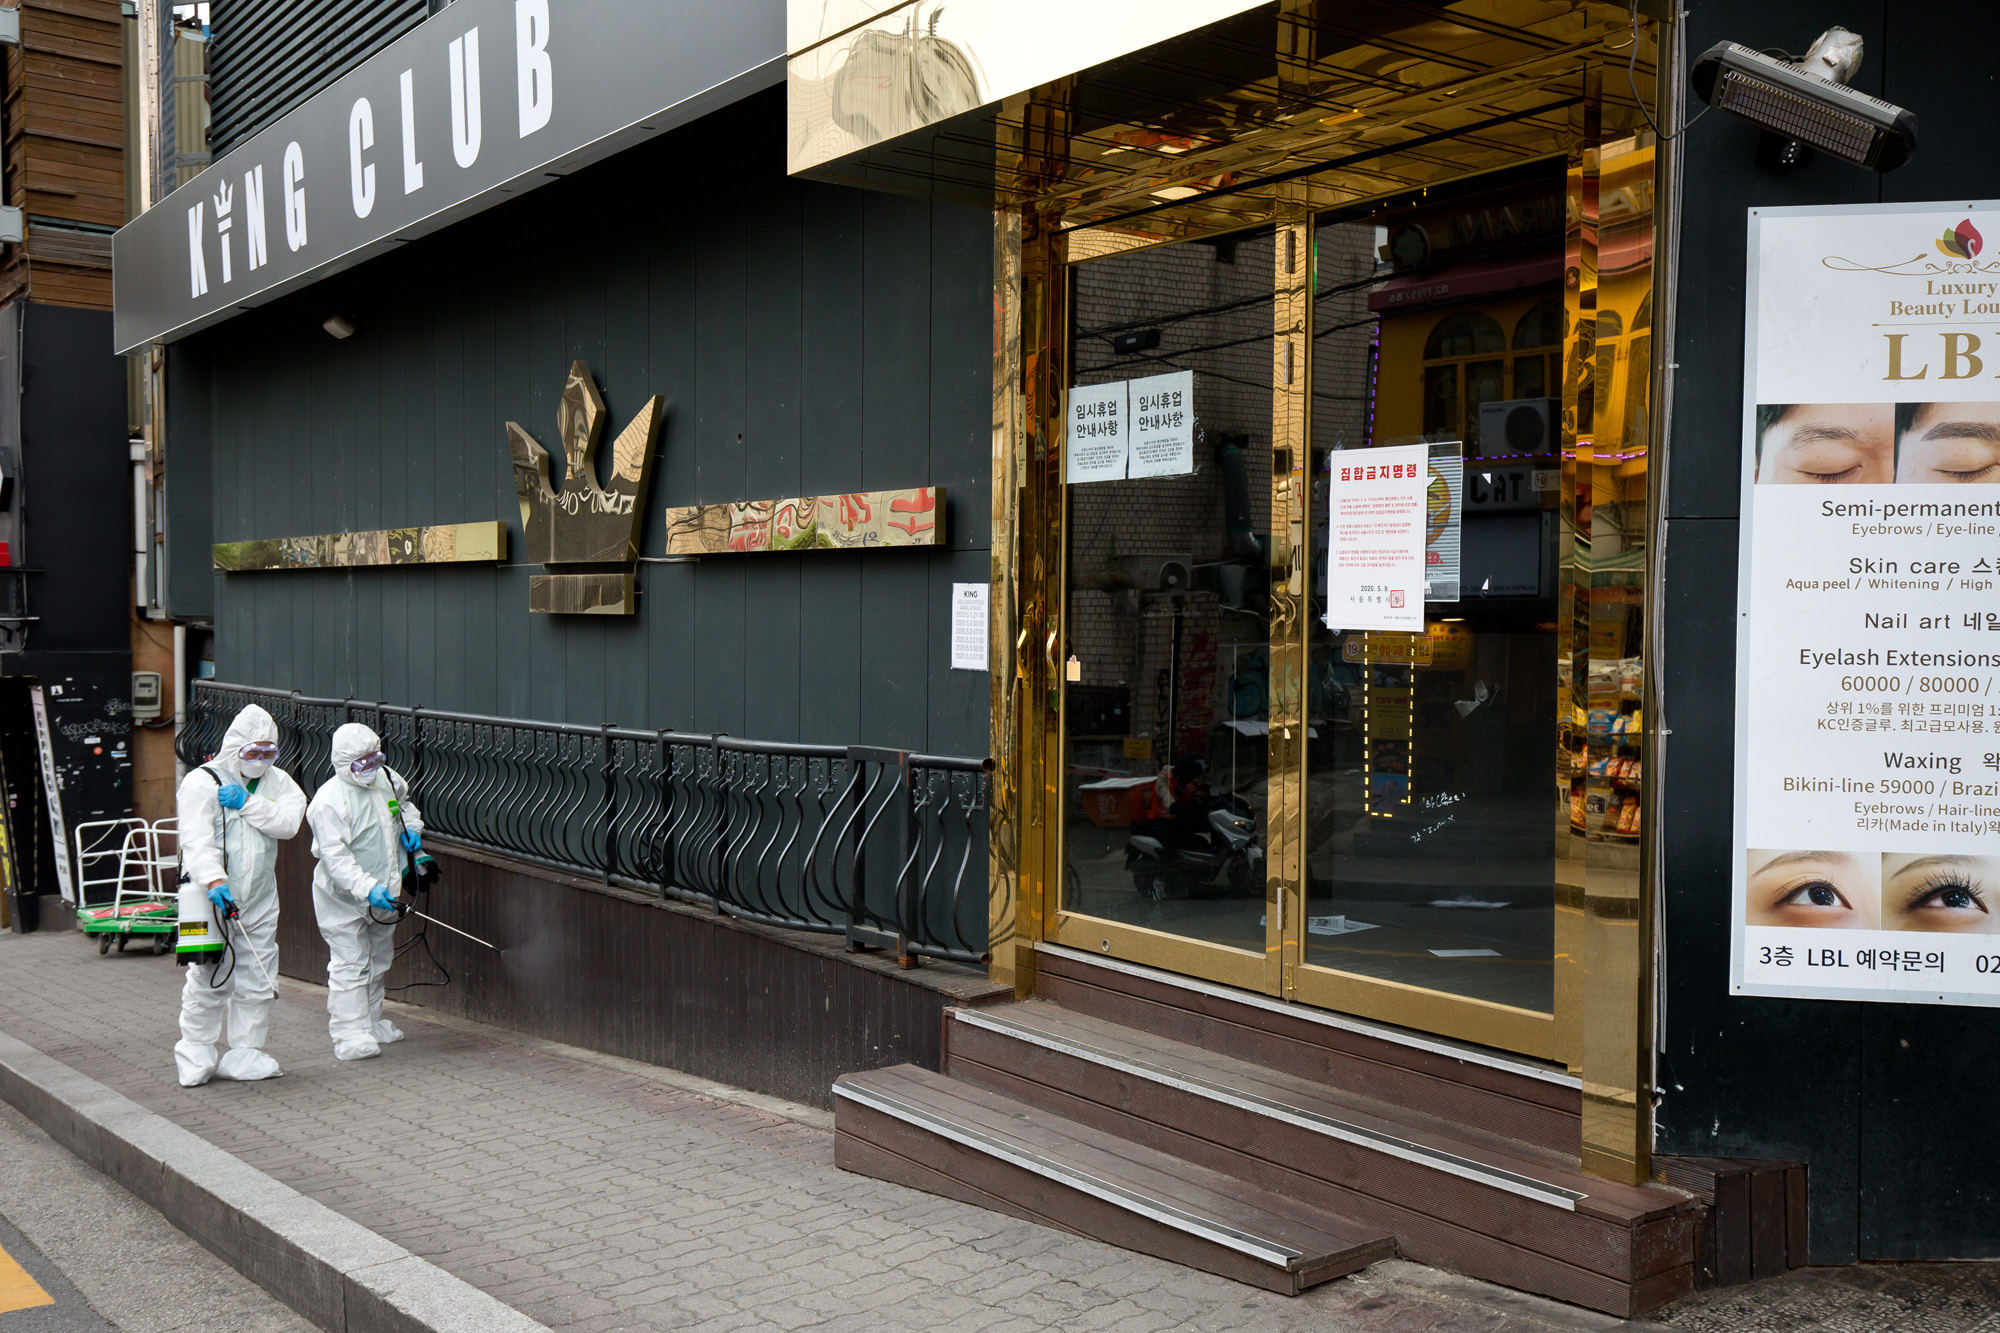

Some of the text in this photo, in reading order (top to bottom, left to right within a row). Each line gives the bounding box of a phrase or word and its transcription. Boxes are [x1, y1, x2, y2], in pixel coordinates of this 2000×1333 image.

[349, 0, 554, 219] CLUB
[1926, 281, 1998, 299] Luxury
[1890, 301, 1956, 319] Beauty
[1882, 333, 2000, 380] LB
[1076, 400, 1118, 419] 임시휴업
[1139, 391, 1182, 411] 임시휴업
[1076, 420, 1118, 439] 안내사항
[1139, 411, 1183, 432] 안내사항
[1340, 463, 1417, 481] 집합금지명령
[1821, 500, 2000, 520] Semi-permanent
[1852, 523, 1923, 537] Eyebrows
[1936, 523, 1995, 538] Eye-line
[1849, 558, 2000, 575] Skin care 스
[1786, 578, 1819, 591] Aqua
[1822, 578, 1850, 591] peel
[1868, 579, 1940, 591] Whitening
[1960, 579, 1993, 591] High
[963, 590, 978, 598] KING
[1865, 613, 1908, 629] Nail
[1919, 613, 1951, 629] art
[1347, 643, 1358, 654] 19
[1800, 648, 2000, 669] Eyelash Extensions
[1841, 676, 1901, 692] 60000
[1919, 677, 1979, 693] 80000
[1826, 701, 1853, 715] 상위
[1858, 702, 1893, 715] 1%를
[1898, 702, 1925, 716] 위한
[1929, 703, 1984, 717] 프리미엄
[1817, 718, 1896, 732] KC인증글루.
[1900, 719, 1989, 734] 최고급모사용.
[1884, 752, 1962, 774] Waxing
[1783, 777, 1875, 793] Bikini-line
[1880, 780, 1935, 795] 59000
[1854, 802, 1925, 817] Eyebrows
[1938, 804, 2000, 818] Hair-line
[1856, 818, 1929, 832] 리카(Made
[1933, 820, 1946, 832] in
[1759, 945, 1795, 967] 3층
[1807, 949, 1849, 967] LBL
[1856, 949, 1945, 973] 예약문의
